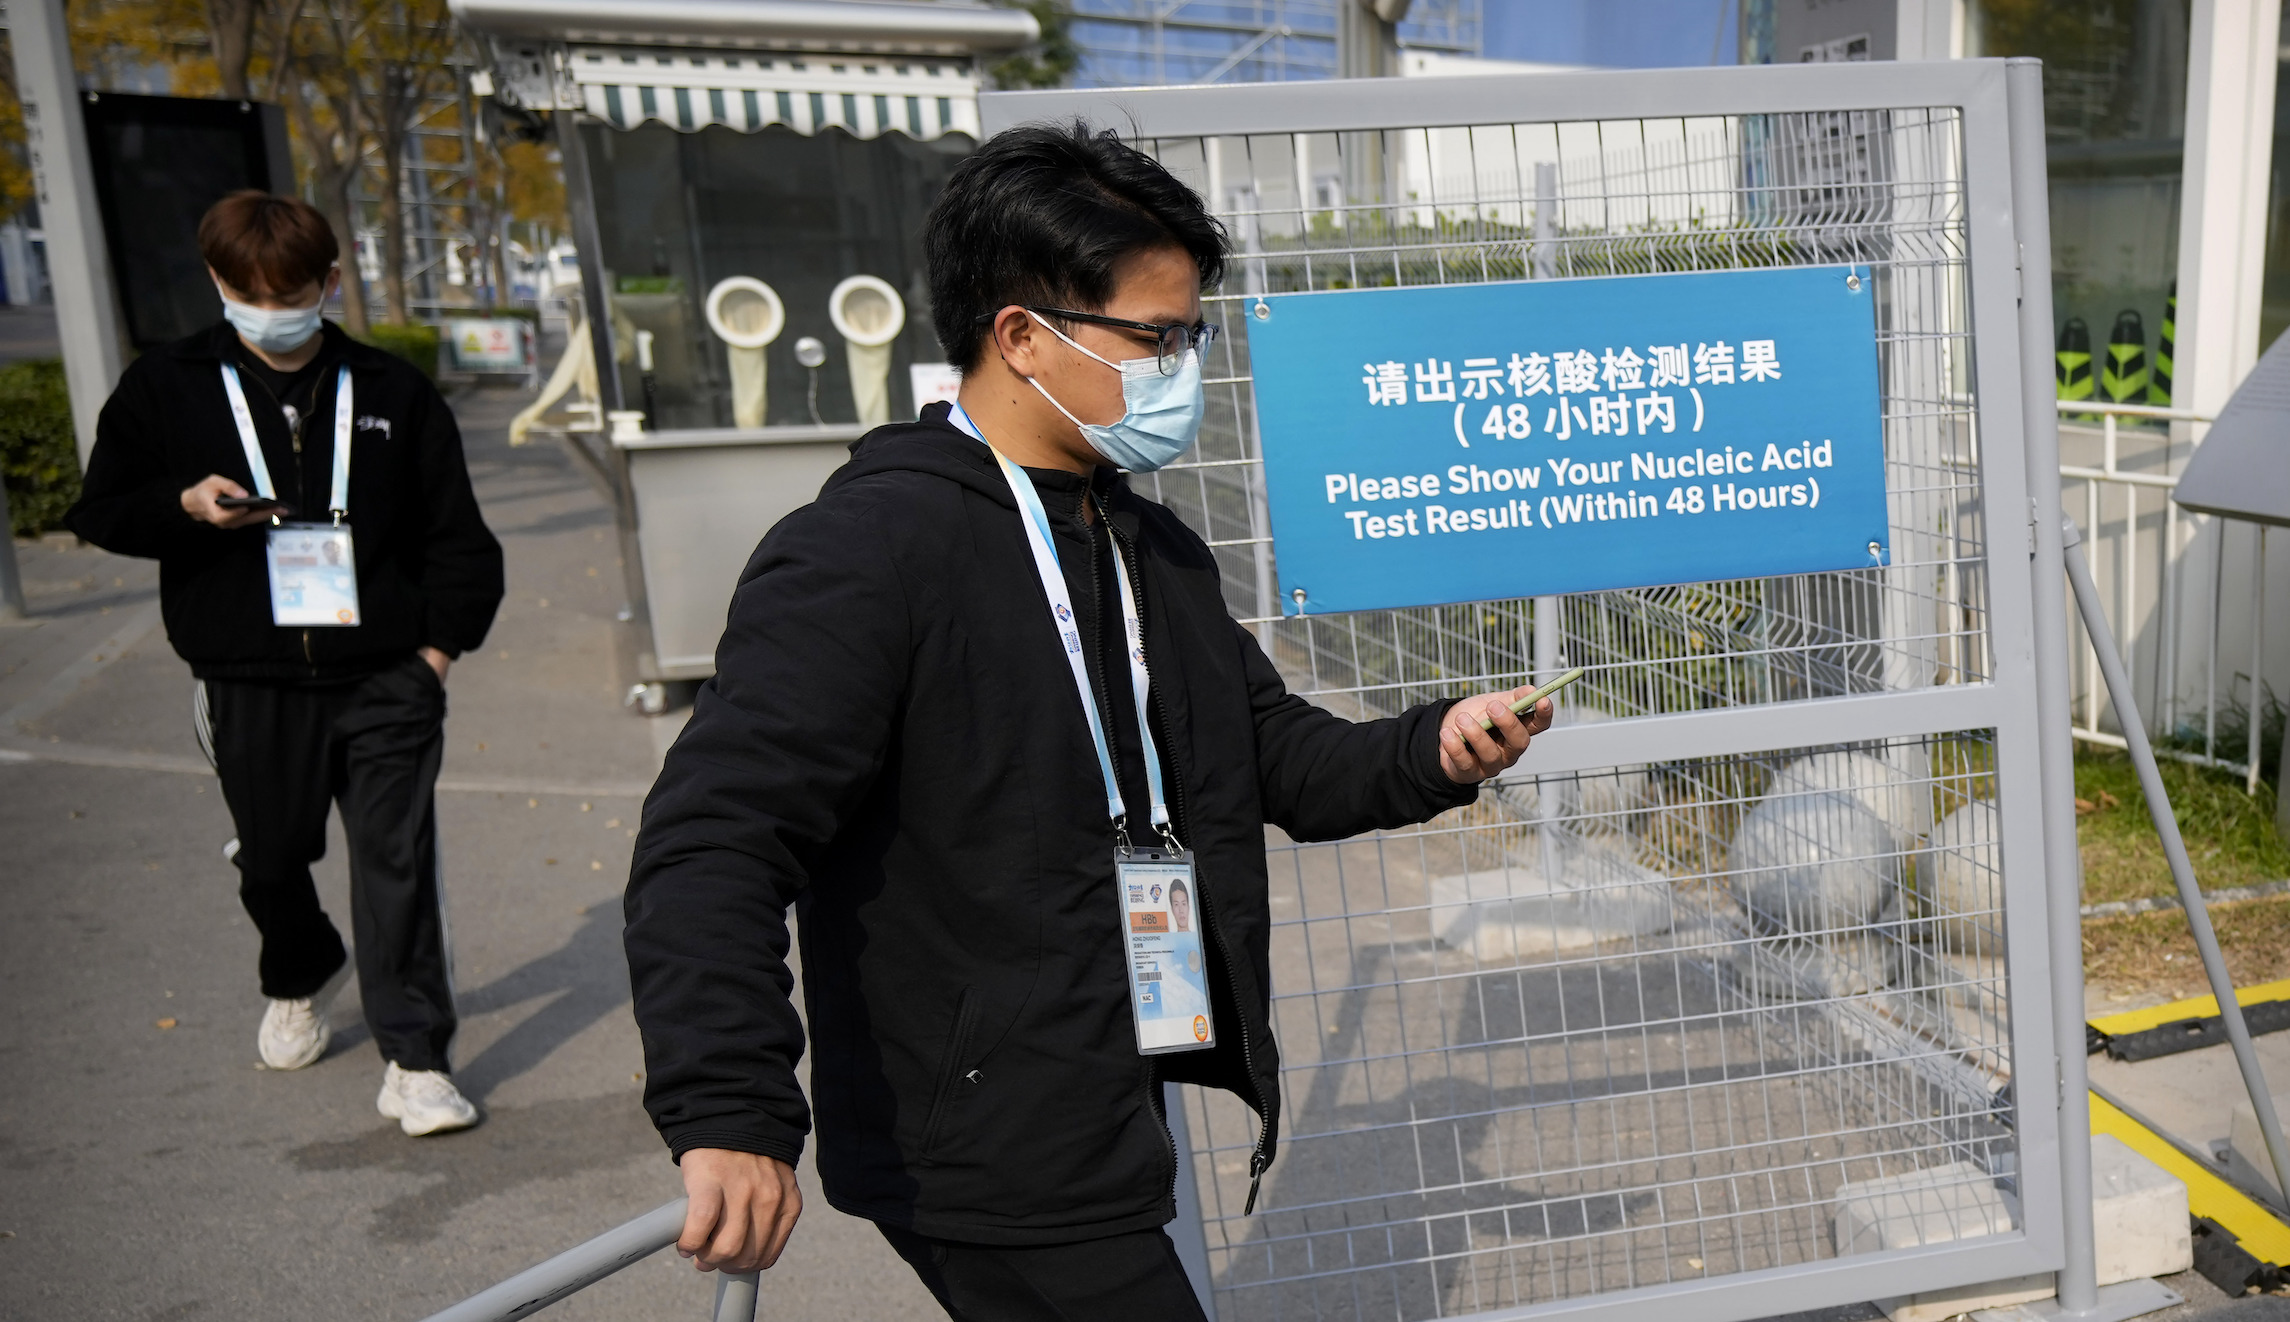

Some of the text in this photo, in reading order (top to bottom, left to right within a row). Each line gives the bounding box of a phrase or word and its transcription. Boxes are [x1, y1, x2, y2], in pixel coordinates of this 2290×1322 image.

[1362, 339, 1782, 407] 请出示核酸检测结果
[1325, 439, 1833, 504] Please Show Your Nucleic Acid
[1344, 476, 1820, 540] Test Result (Within 48 Hours)
